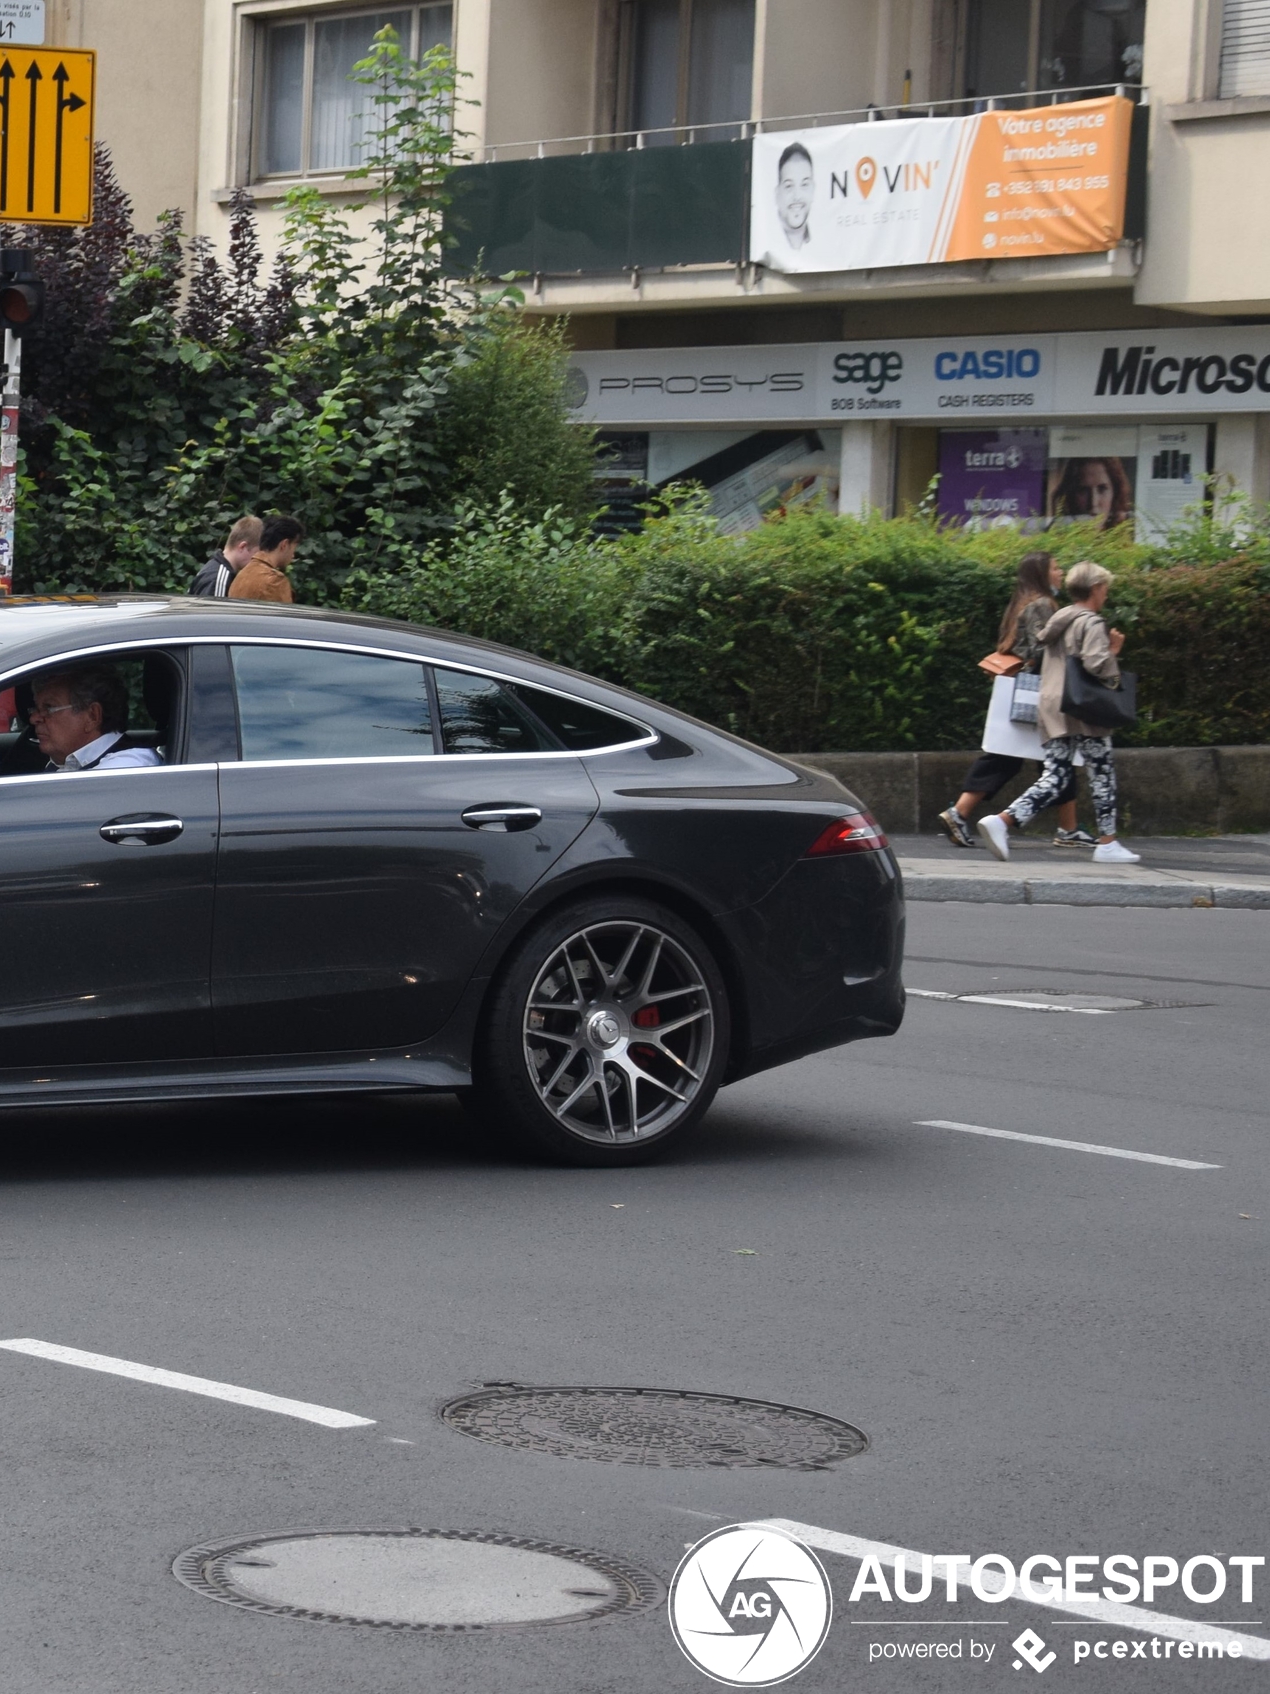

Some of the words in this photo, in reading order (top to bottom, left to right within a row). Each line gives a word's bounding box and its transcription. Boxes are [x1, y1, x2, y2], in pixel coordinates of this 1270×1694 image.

[997, 116, 1043, 135] Votre
[1045, 113, 1106, 138] agence
[837, 214, 868, 227] REAL
[872, 207, 920, 225] ESTATE
[833, 351, 903, 394] sage
[935, 348, 1041, 380] CASIO
[599, 372, 804, 395] PROSYS
[832, 399, 854, 411] BOB
[858, 398, 902, 410] Software
[938, 395, 969, 408] CASH
[972, 393, 1034, 407] REGISTERS
[965, 450, 1005, 466] terra
[964, 498, 1018, 512] WINDOWS
